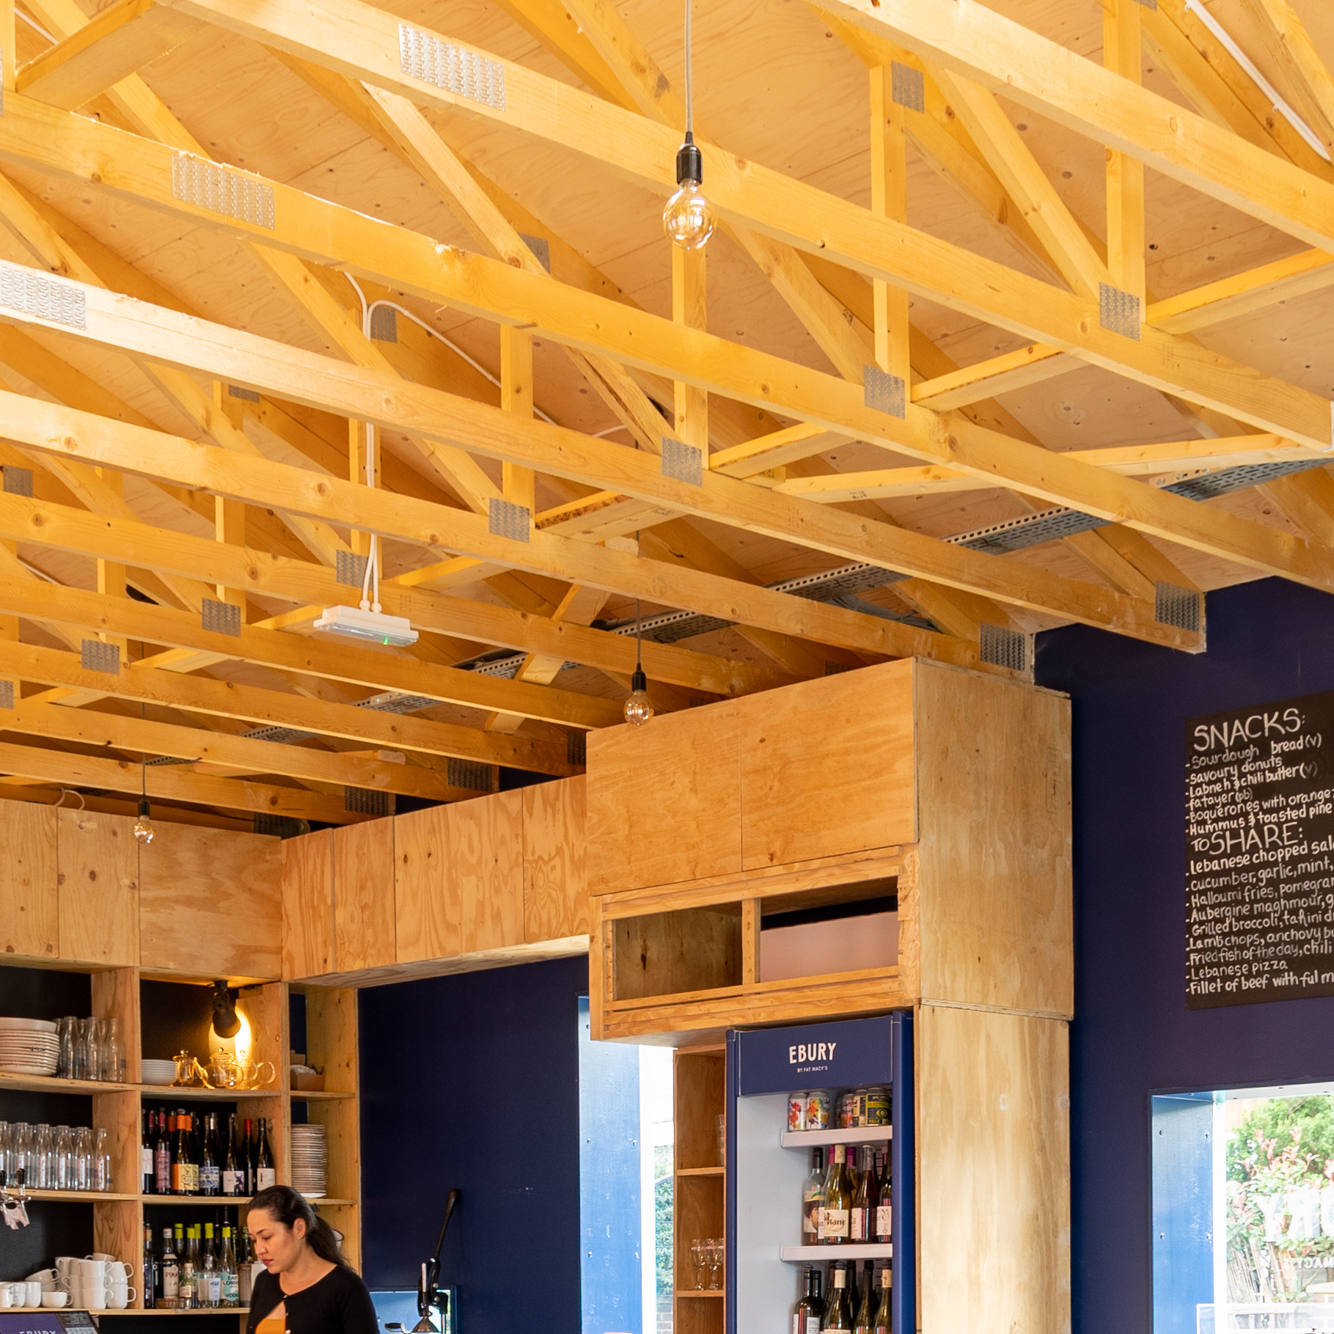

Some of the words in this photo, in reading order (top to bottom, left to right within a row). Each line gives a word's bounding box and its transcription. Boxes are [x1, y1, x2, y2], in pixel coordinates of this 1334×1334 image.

[1241, 755, 1282, 773] donuts
[1262, 794, 1286, 810] with
[1257, 803, 1307, 825] toasted
[1309, 802, 1333, 819] pine
[1251, 960, 1288, 975] pizza
[1241, 974, 1270, 990] beef
[789, 1042, 837, 1064] EBURY
